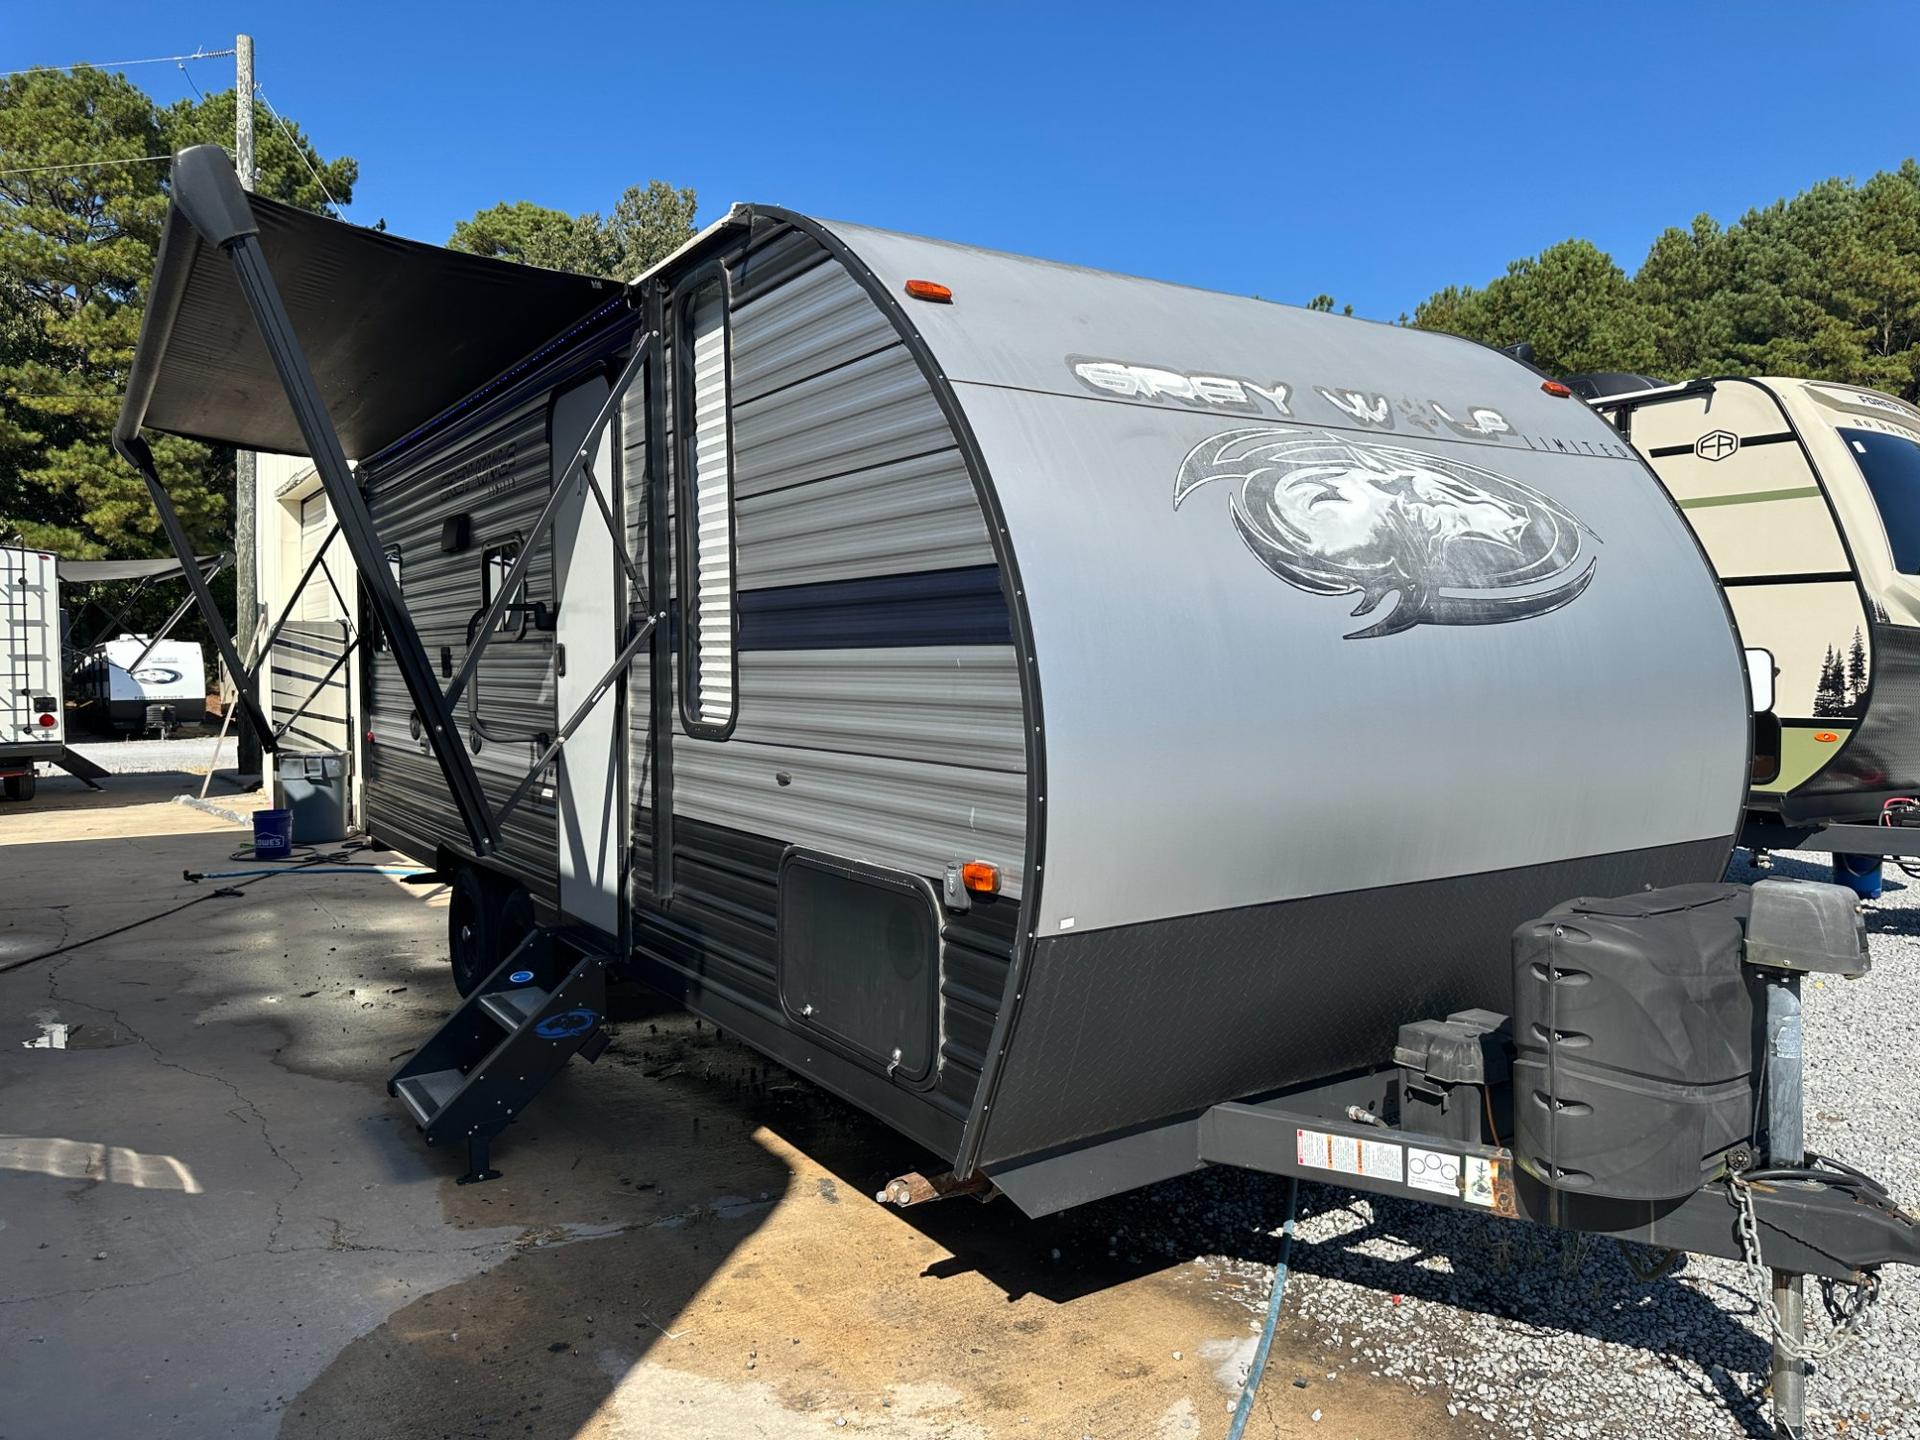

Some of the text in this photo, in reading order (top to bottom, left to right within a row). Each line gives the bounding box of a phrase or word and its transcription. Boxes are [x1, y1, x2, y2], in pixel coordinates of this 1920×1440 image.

[1065, 353, 1294, 416] GREY
[1522, 434, 1628, 458] LIMITED
[1700, 434, 1734, 457] FR
